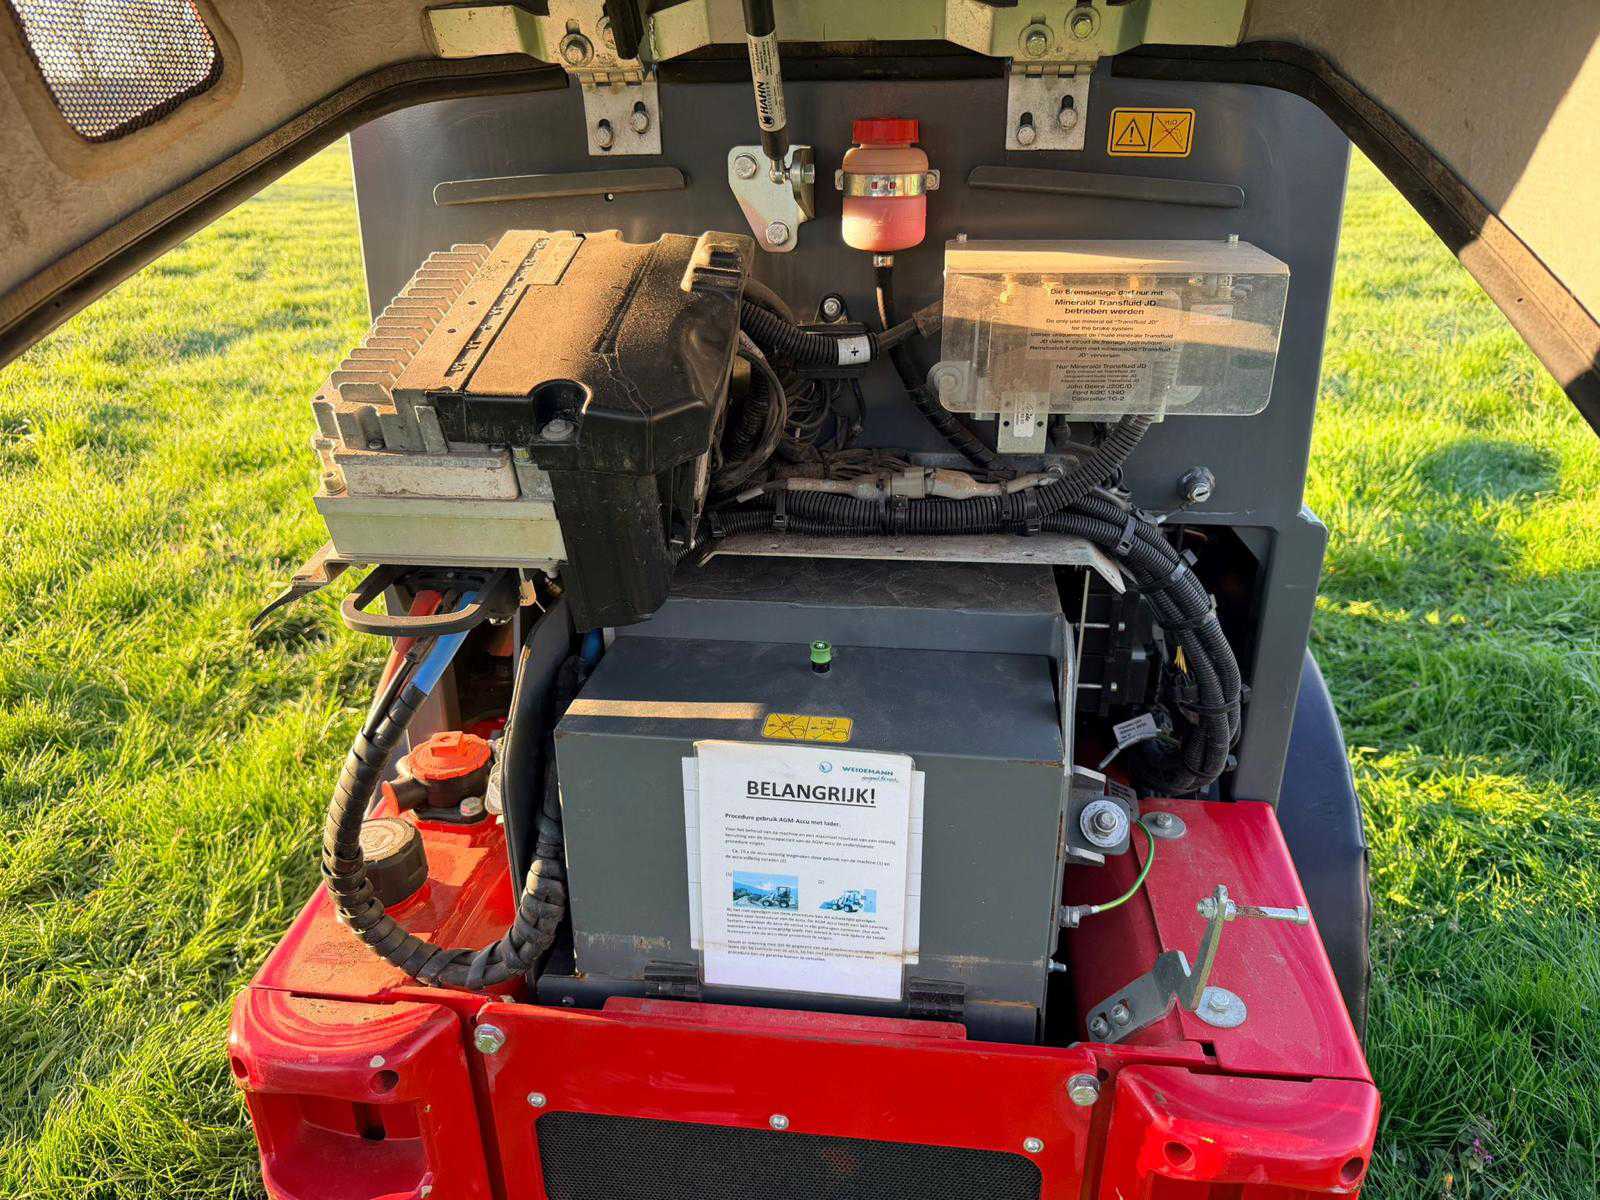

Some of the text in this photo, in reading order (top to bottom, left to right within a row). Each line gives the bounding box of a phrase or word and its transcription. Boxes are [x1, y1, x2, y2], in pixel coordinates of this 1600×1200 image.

[757, 81, 769, 114] HAHN
[1065, 289, 1117, 297] Bremsanlage
[841, 766, 894, 776] WEIDEMANN
[746, 780, 877, 806] BELANGRIJK!
[724, 812, 755, 821] Procedure
[755, 816, 778, 824] gebruik
